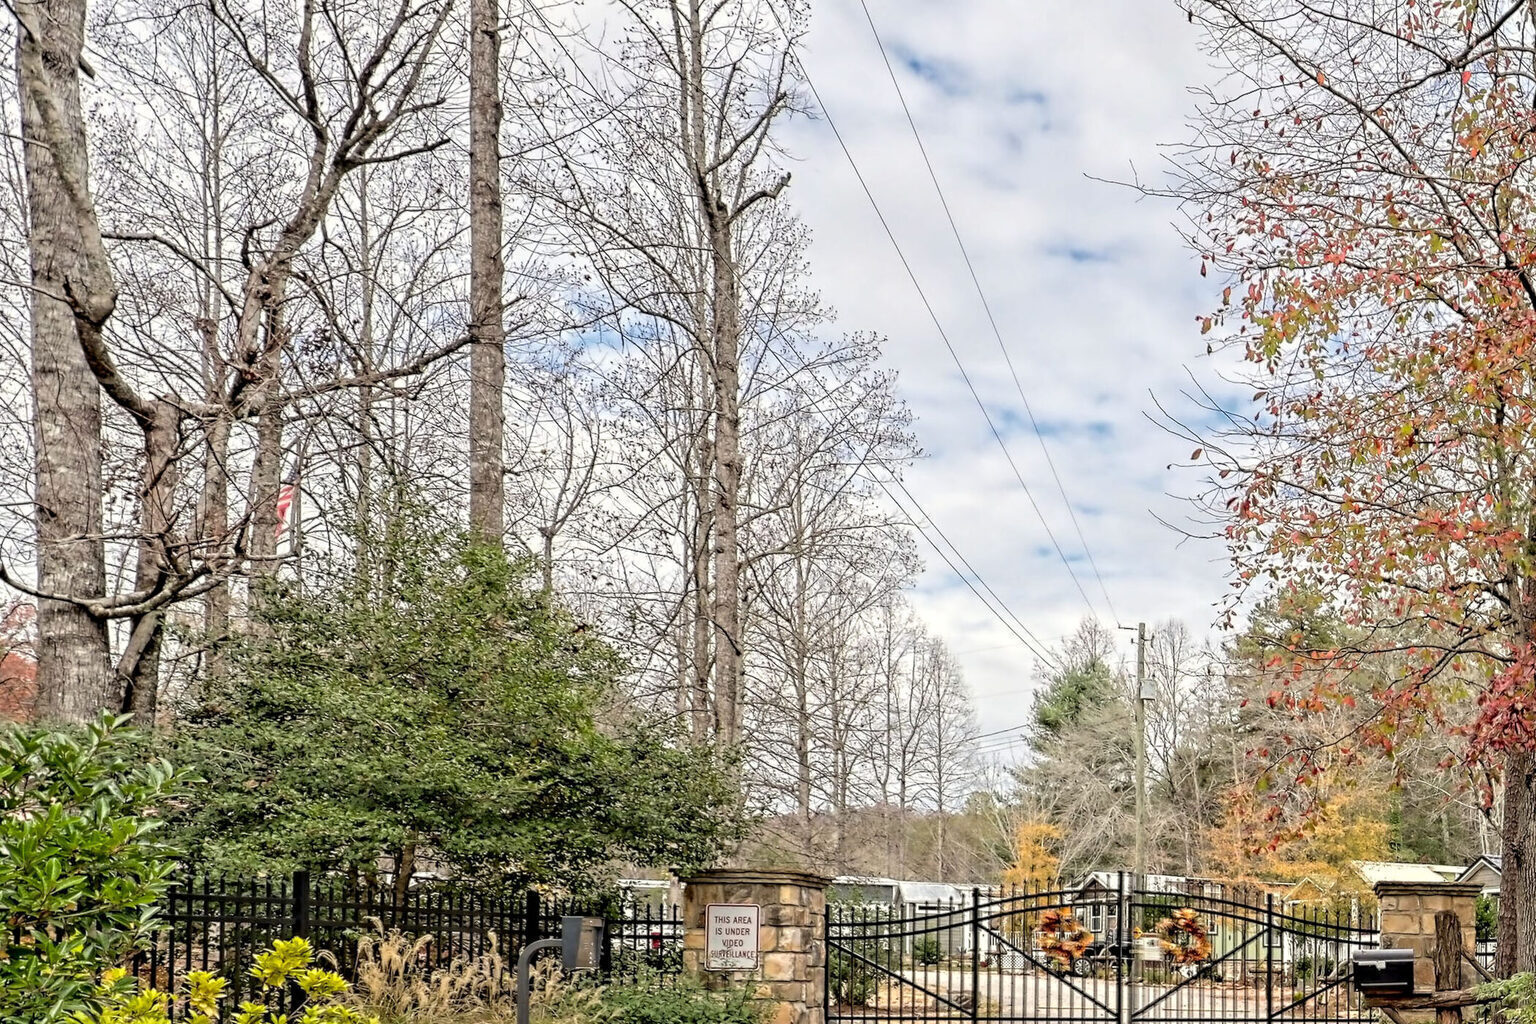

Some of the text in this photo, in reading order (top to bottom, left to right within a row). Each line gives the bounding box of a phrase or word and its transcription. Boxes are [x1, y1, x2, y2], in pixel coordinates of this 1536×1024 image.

[714, 916, 752, 924] THIS AREA
[715, 927, 723, 935] IS
[722, 939, 744, 947] VIDEO
[711, 950, 755, 958] SURVEILLANCE
